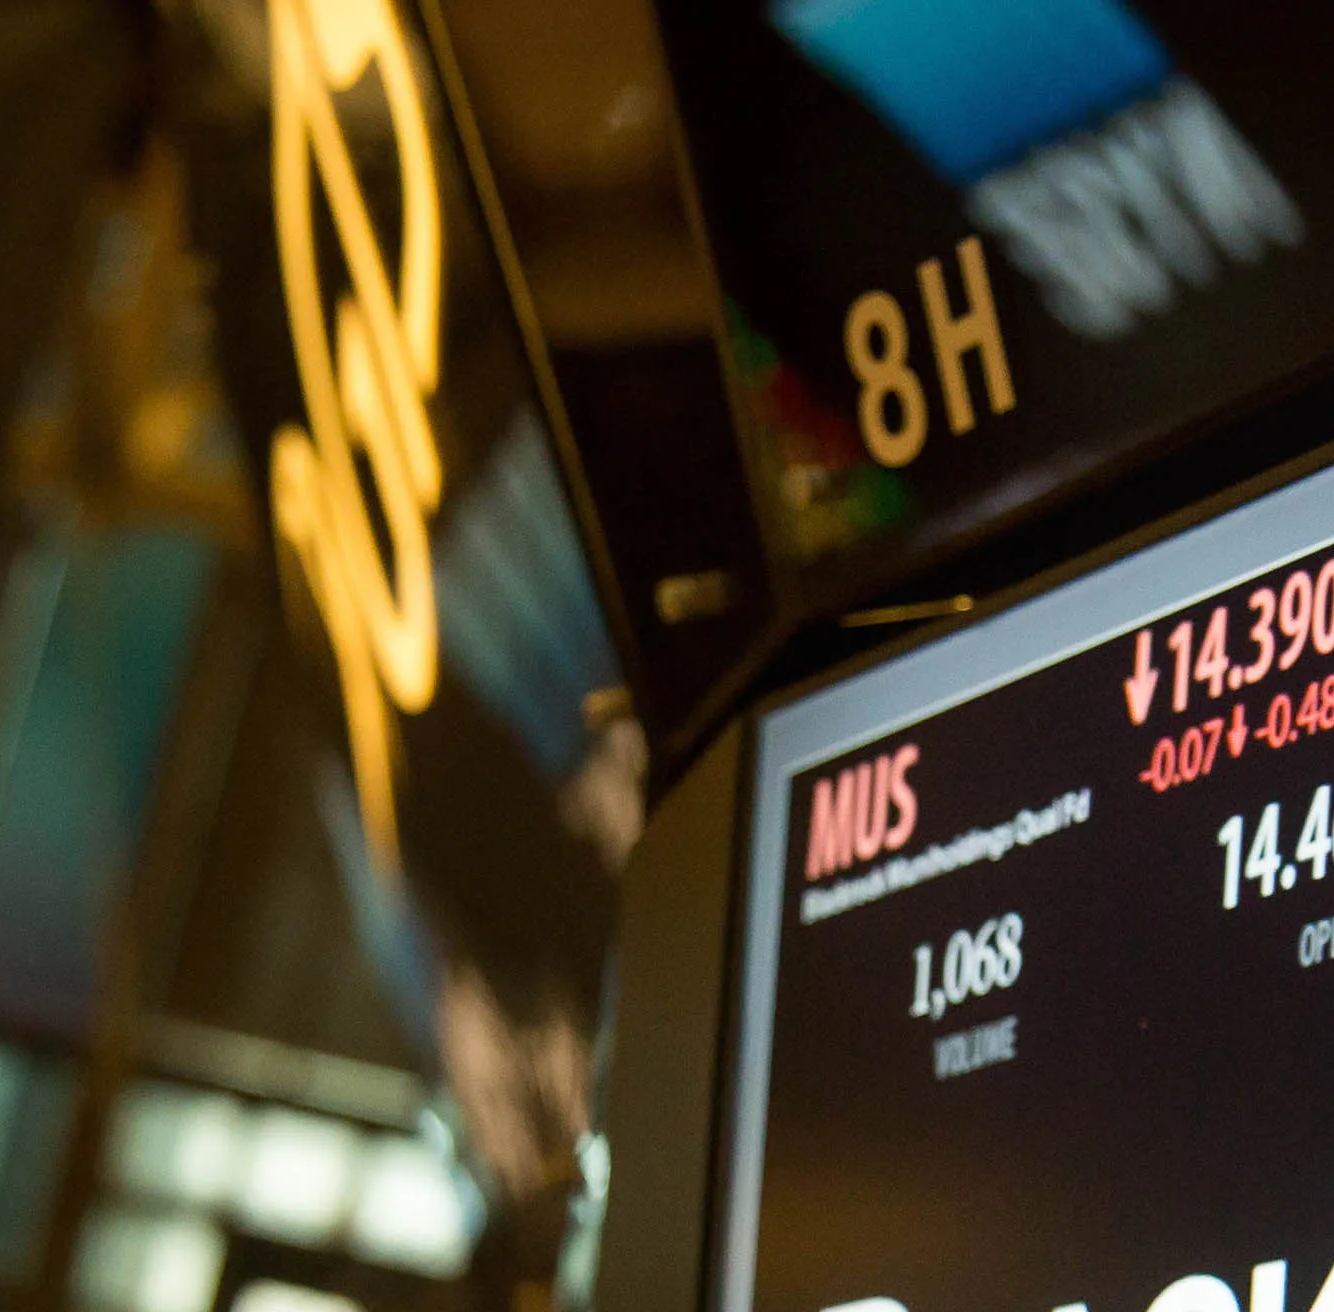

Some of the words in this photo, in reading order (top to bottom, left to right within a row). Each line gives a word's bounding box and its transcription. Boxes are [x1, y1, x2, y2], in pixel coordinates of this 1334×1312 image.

[844, 236, 1016, 468] 8H
[805, 743, 921, 882] MUS
[1136, 726, 1224, 794] -0.07
[910, 911, 1024, 1020] 1,068
